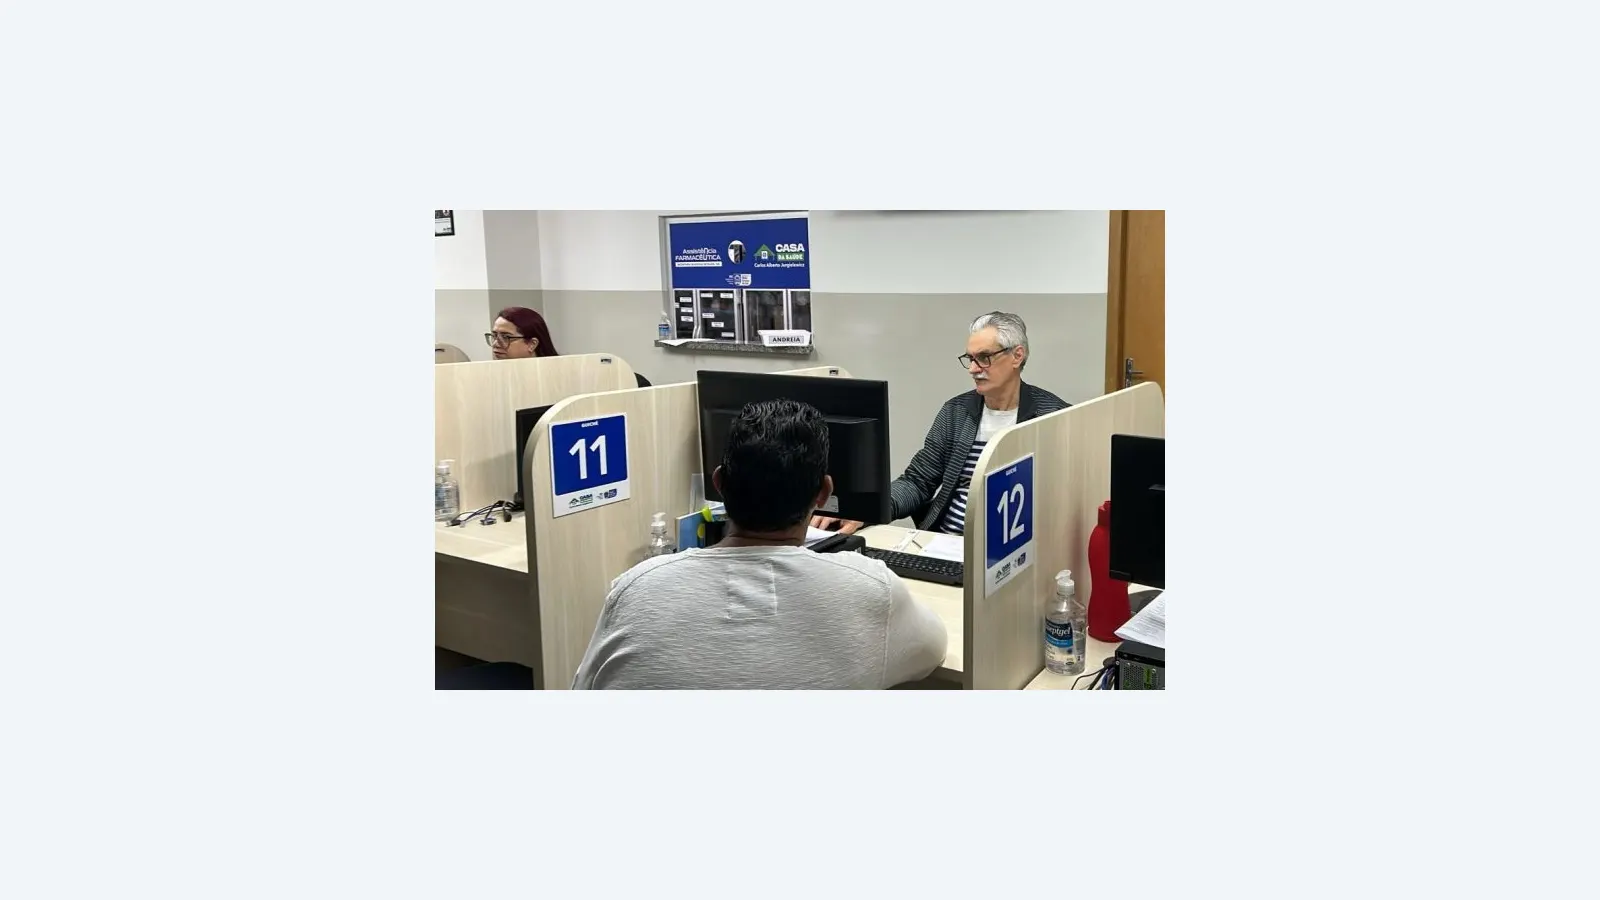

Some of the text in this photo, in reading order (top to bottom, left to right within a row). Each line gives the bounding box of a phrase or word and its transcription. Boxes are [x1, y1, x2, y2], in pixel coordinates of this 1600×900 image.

[675, 253, 721, 261] FARMACÊUTICA
[775, 243, 805, 252] CASA
[568, 434, 608, 480] 11
[997, 482, 1025, 545] 12
